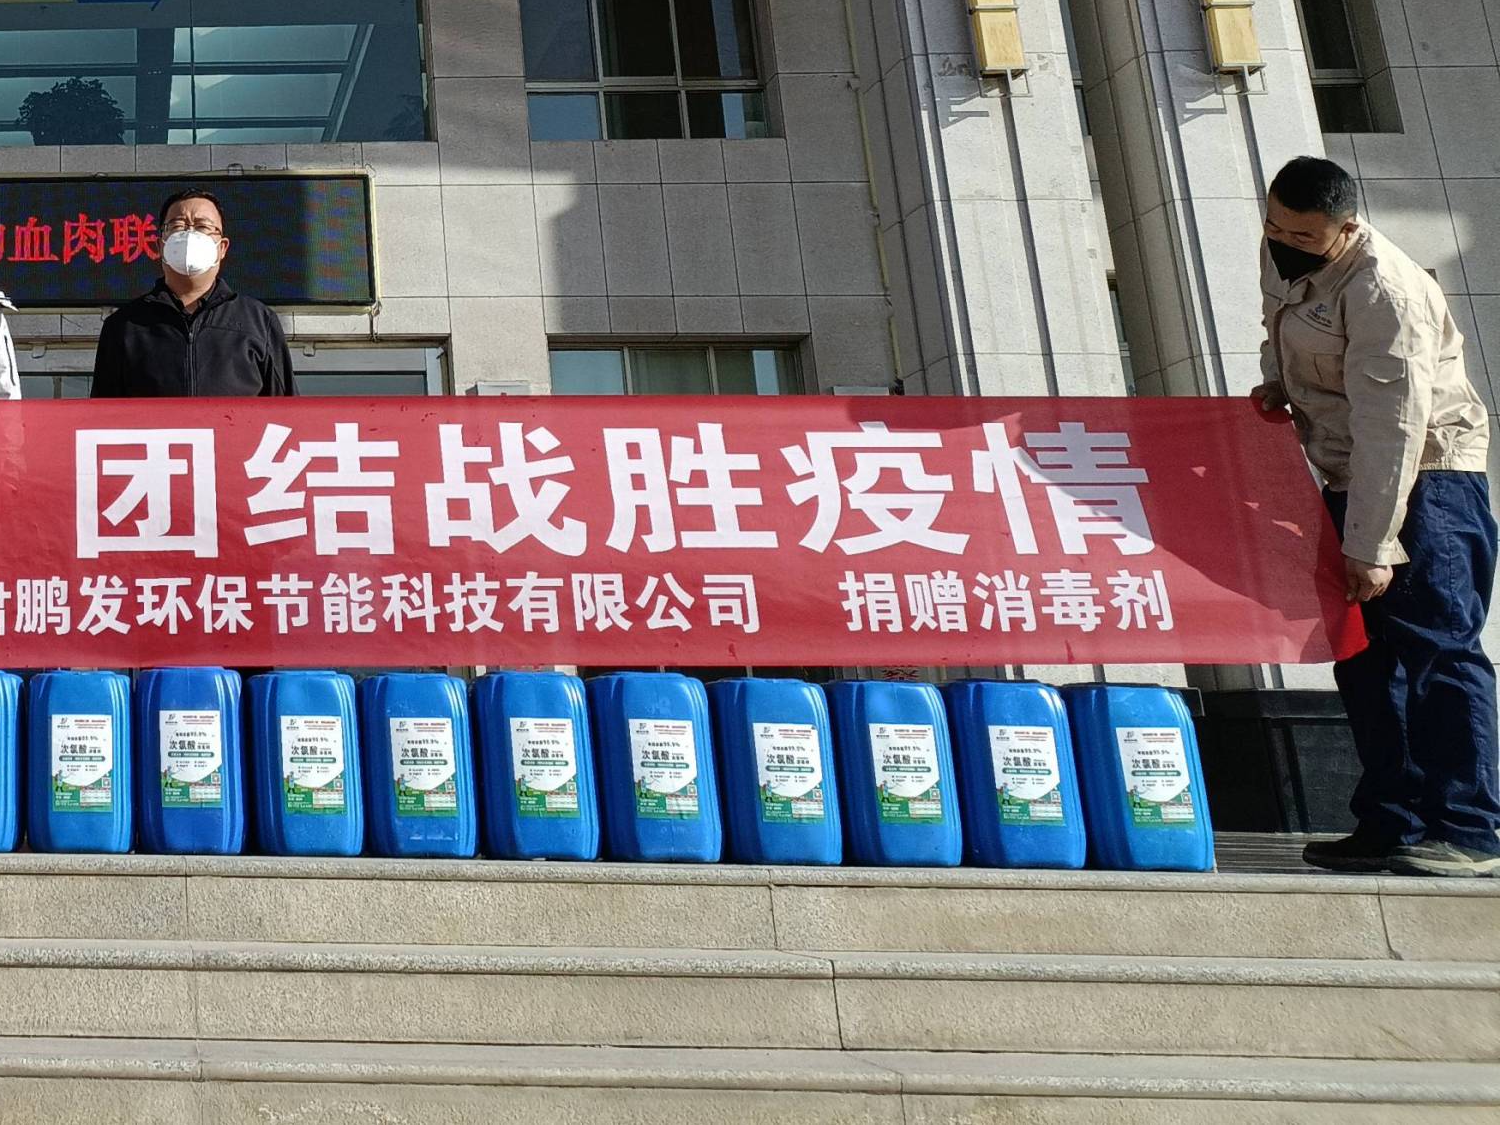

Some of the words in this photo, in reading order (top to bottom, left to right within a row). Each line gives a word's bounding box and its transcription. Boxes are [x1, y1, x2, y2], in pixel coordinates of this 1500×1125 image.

[74, 420, 1157, 560] 团结战胜疫情
[838, 566, 1175, 634] 捐赠消毒剂
